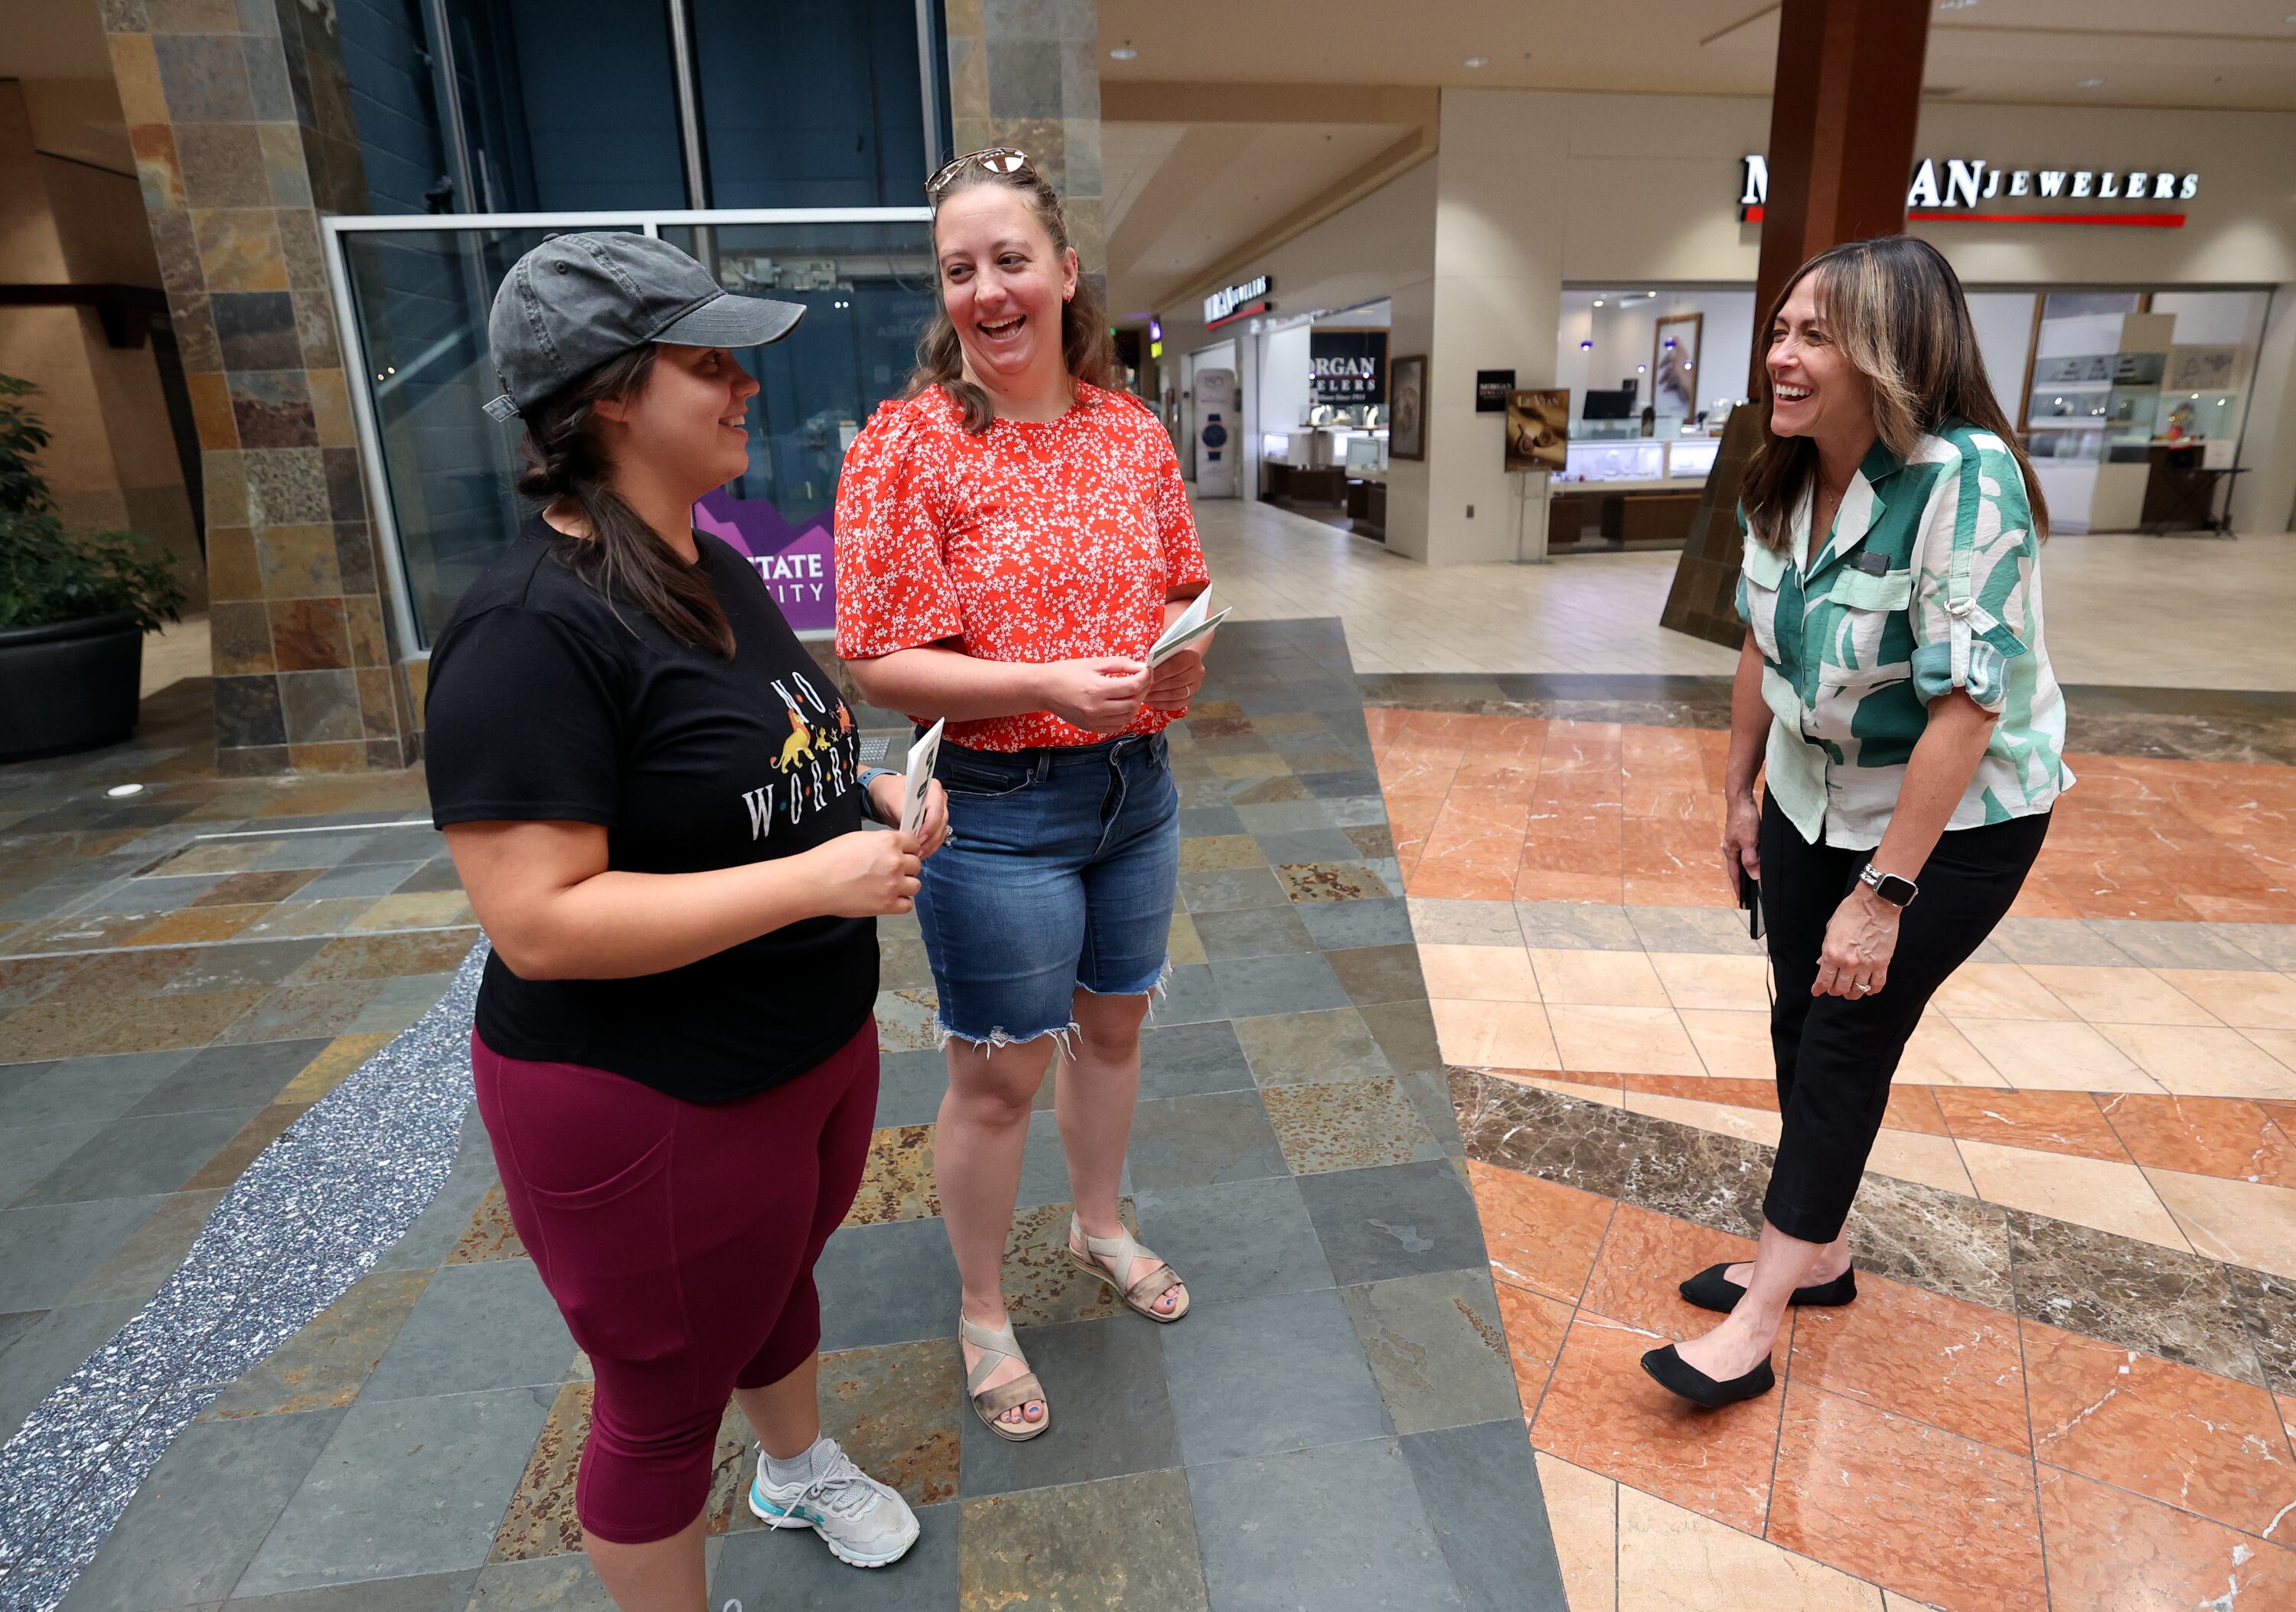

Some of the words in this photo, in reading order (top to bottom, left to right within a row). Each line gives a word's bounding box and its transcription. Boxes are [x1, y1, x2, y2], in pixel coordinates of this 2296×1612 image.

[1740, 155, 1987, 208] MAN
[1982, 170, 2199, 199] JEWELERS
[1310, 357, 1375, 376] RGAN
[746, 553, 823, 579] TATE
[766, 582, 823, 603] ITY
[771, 671, 826, 723] NO
[742, 737, 856, 841] WORRI
